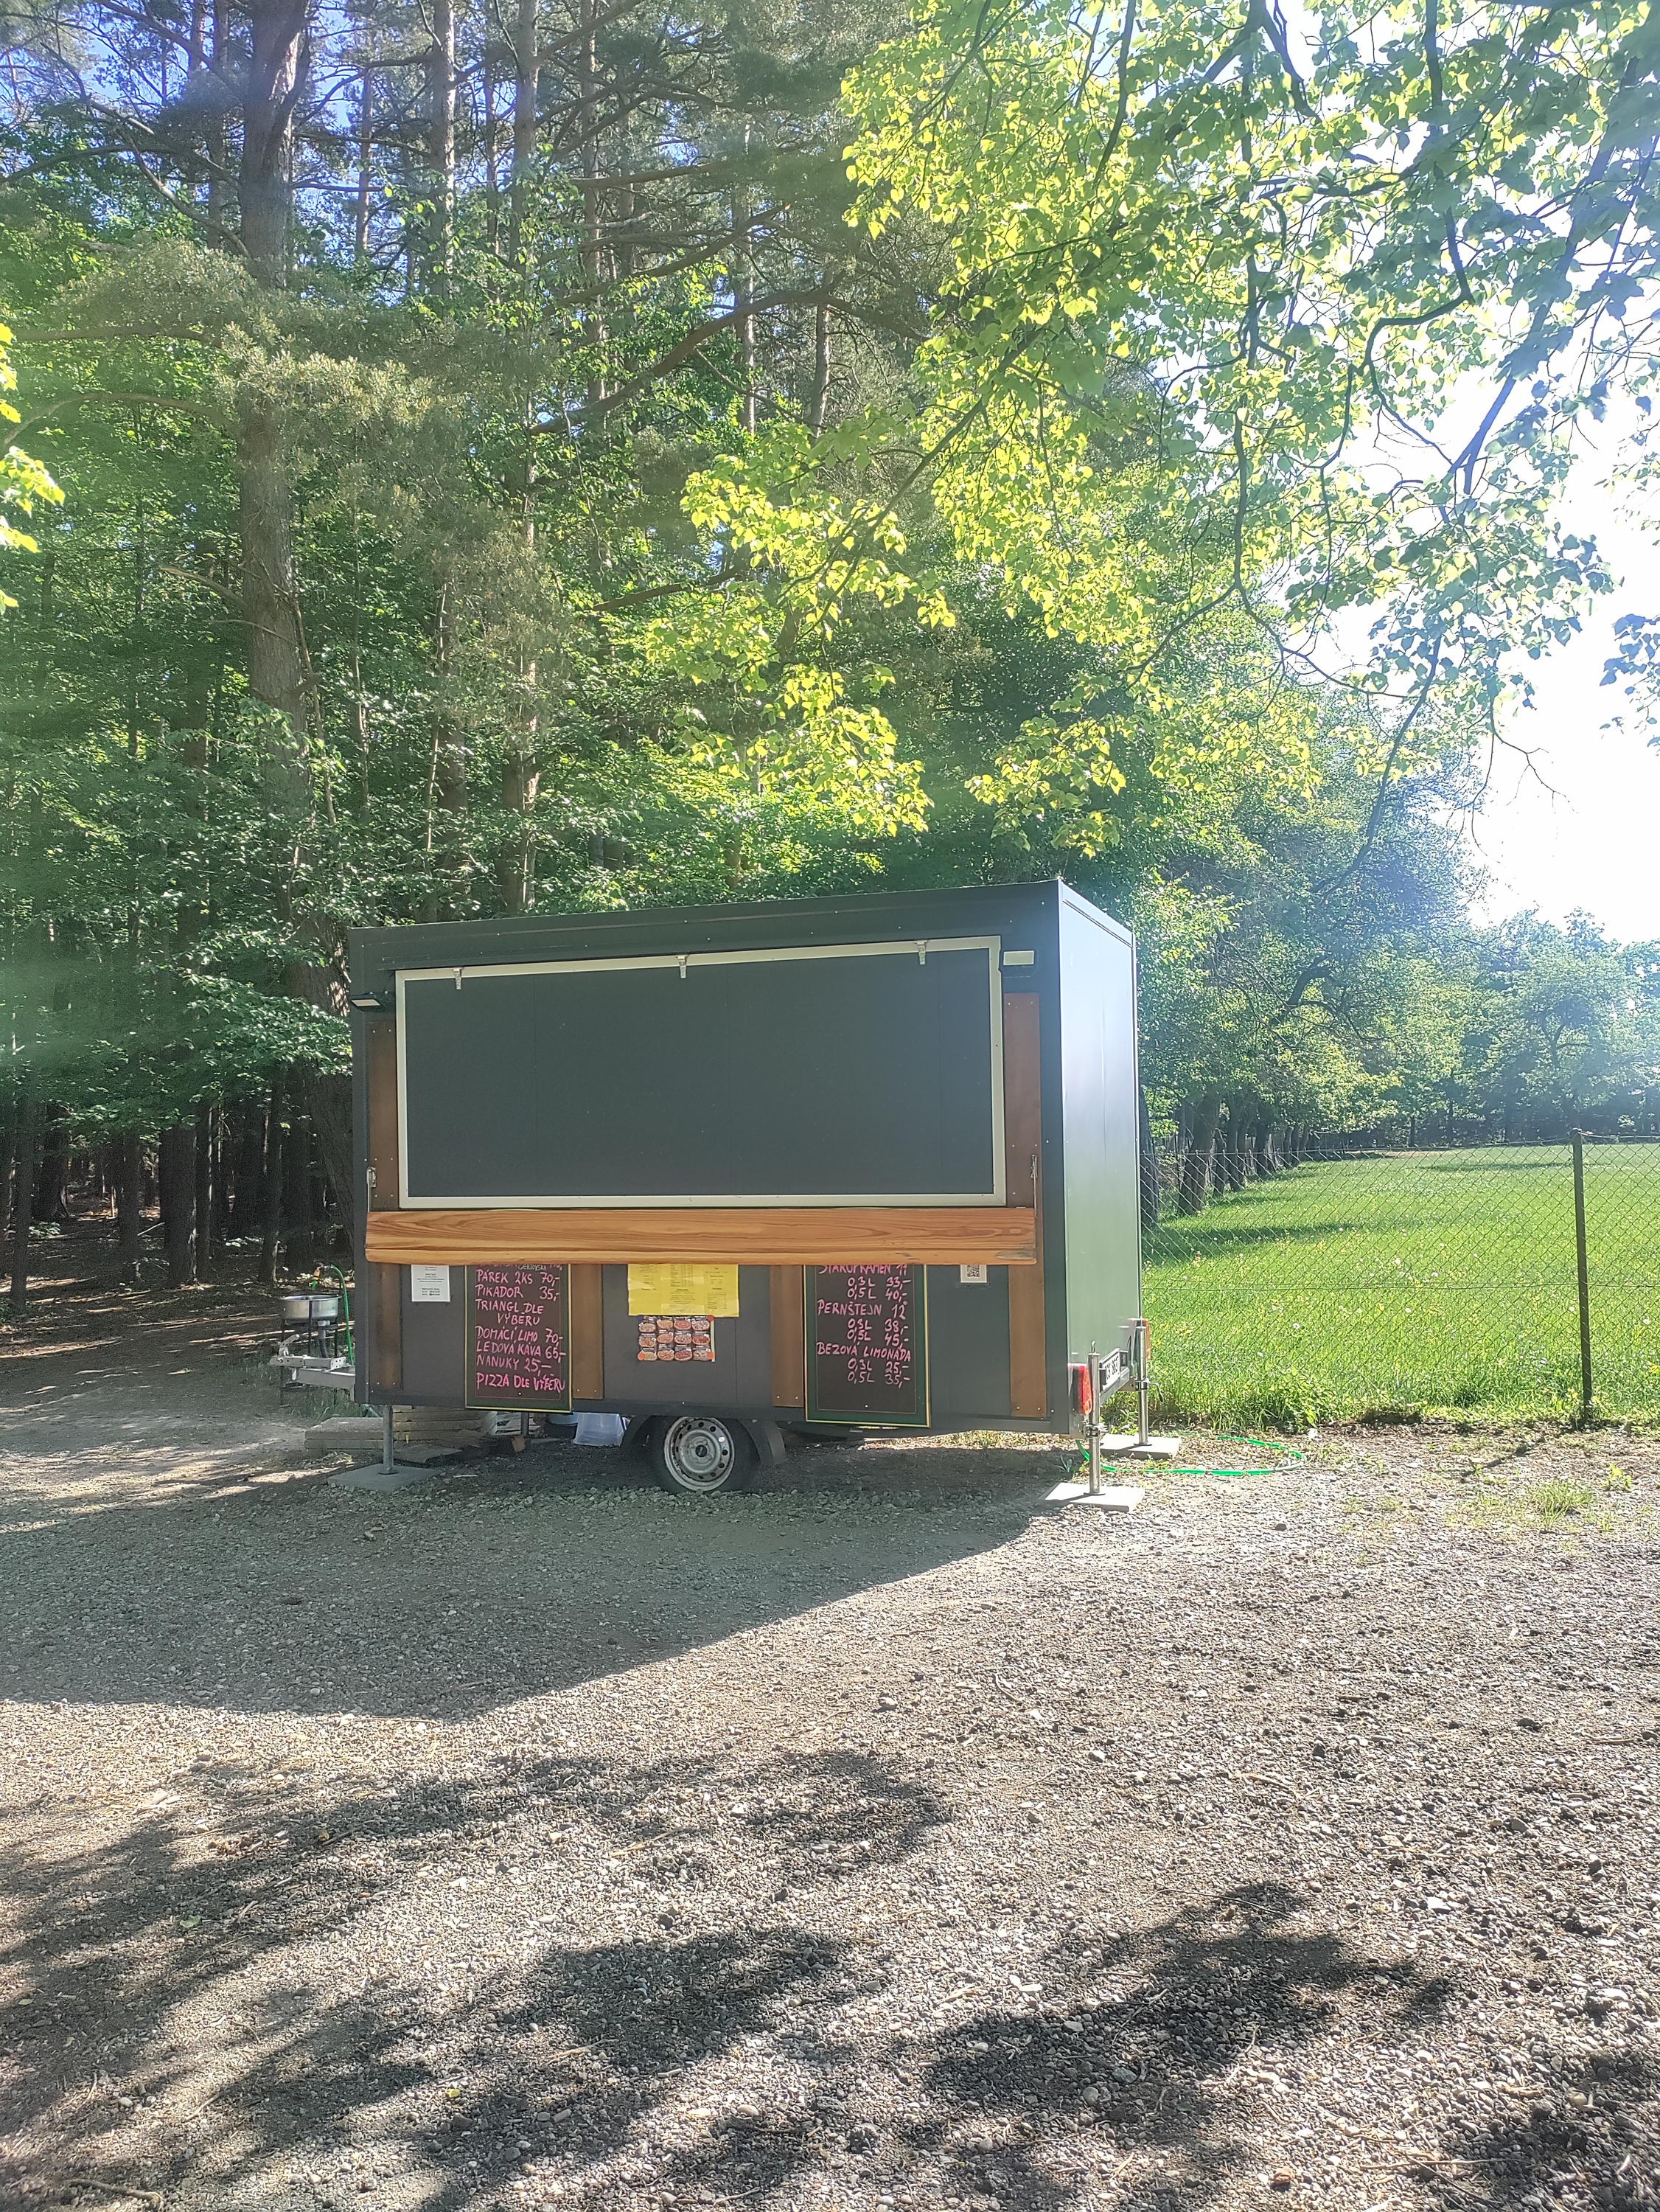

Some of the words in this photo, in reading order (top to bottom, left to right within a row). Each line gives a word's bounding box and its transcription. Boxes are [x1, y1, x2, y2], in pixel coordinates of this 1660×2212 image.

[476, 1269, 509, 1283] PÁREK
[515, 1271, 533, 1284] 2KS
[475, 1284, 523, 1298] PIKADOR
[475, 1299, 519, 1312] TRIANGL
[523, 1302, 544, 1314] DLE
[817, 1299, 882, 1315] PERNŠTEJN
[518, 1329, 538, 1341] LIMO
[517, 1342, 541, 1356] KÁVA
[477, 1354, 519, 1370] NANUKY
[476, 1372, 509, 1390] PIZZA
[514, 1375, 530, 1388] DLE
